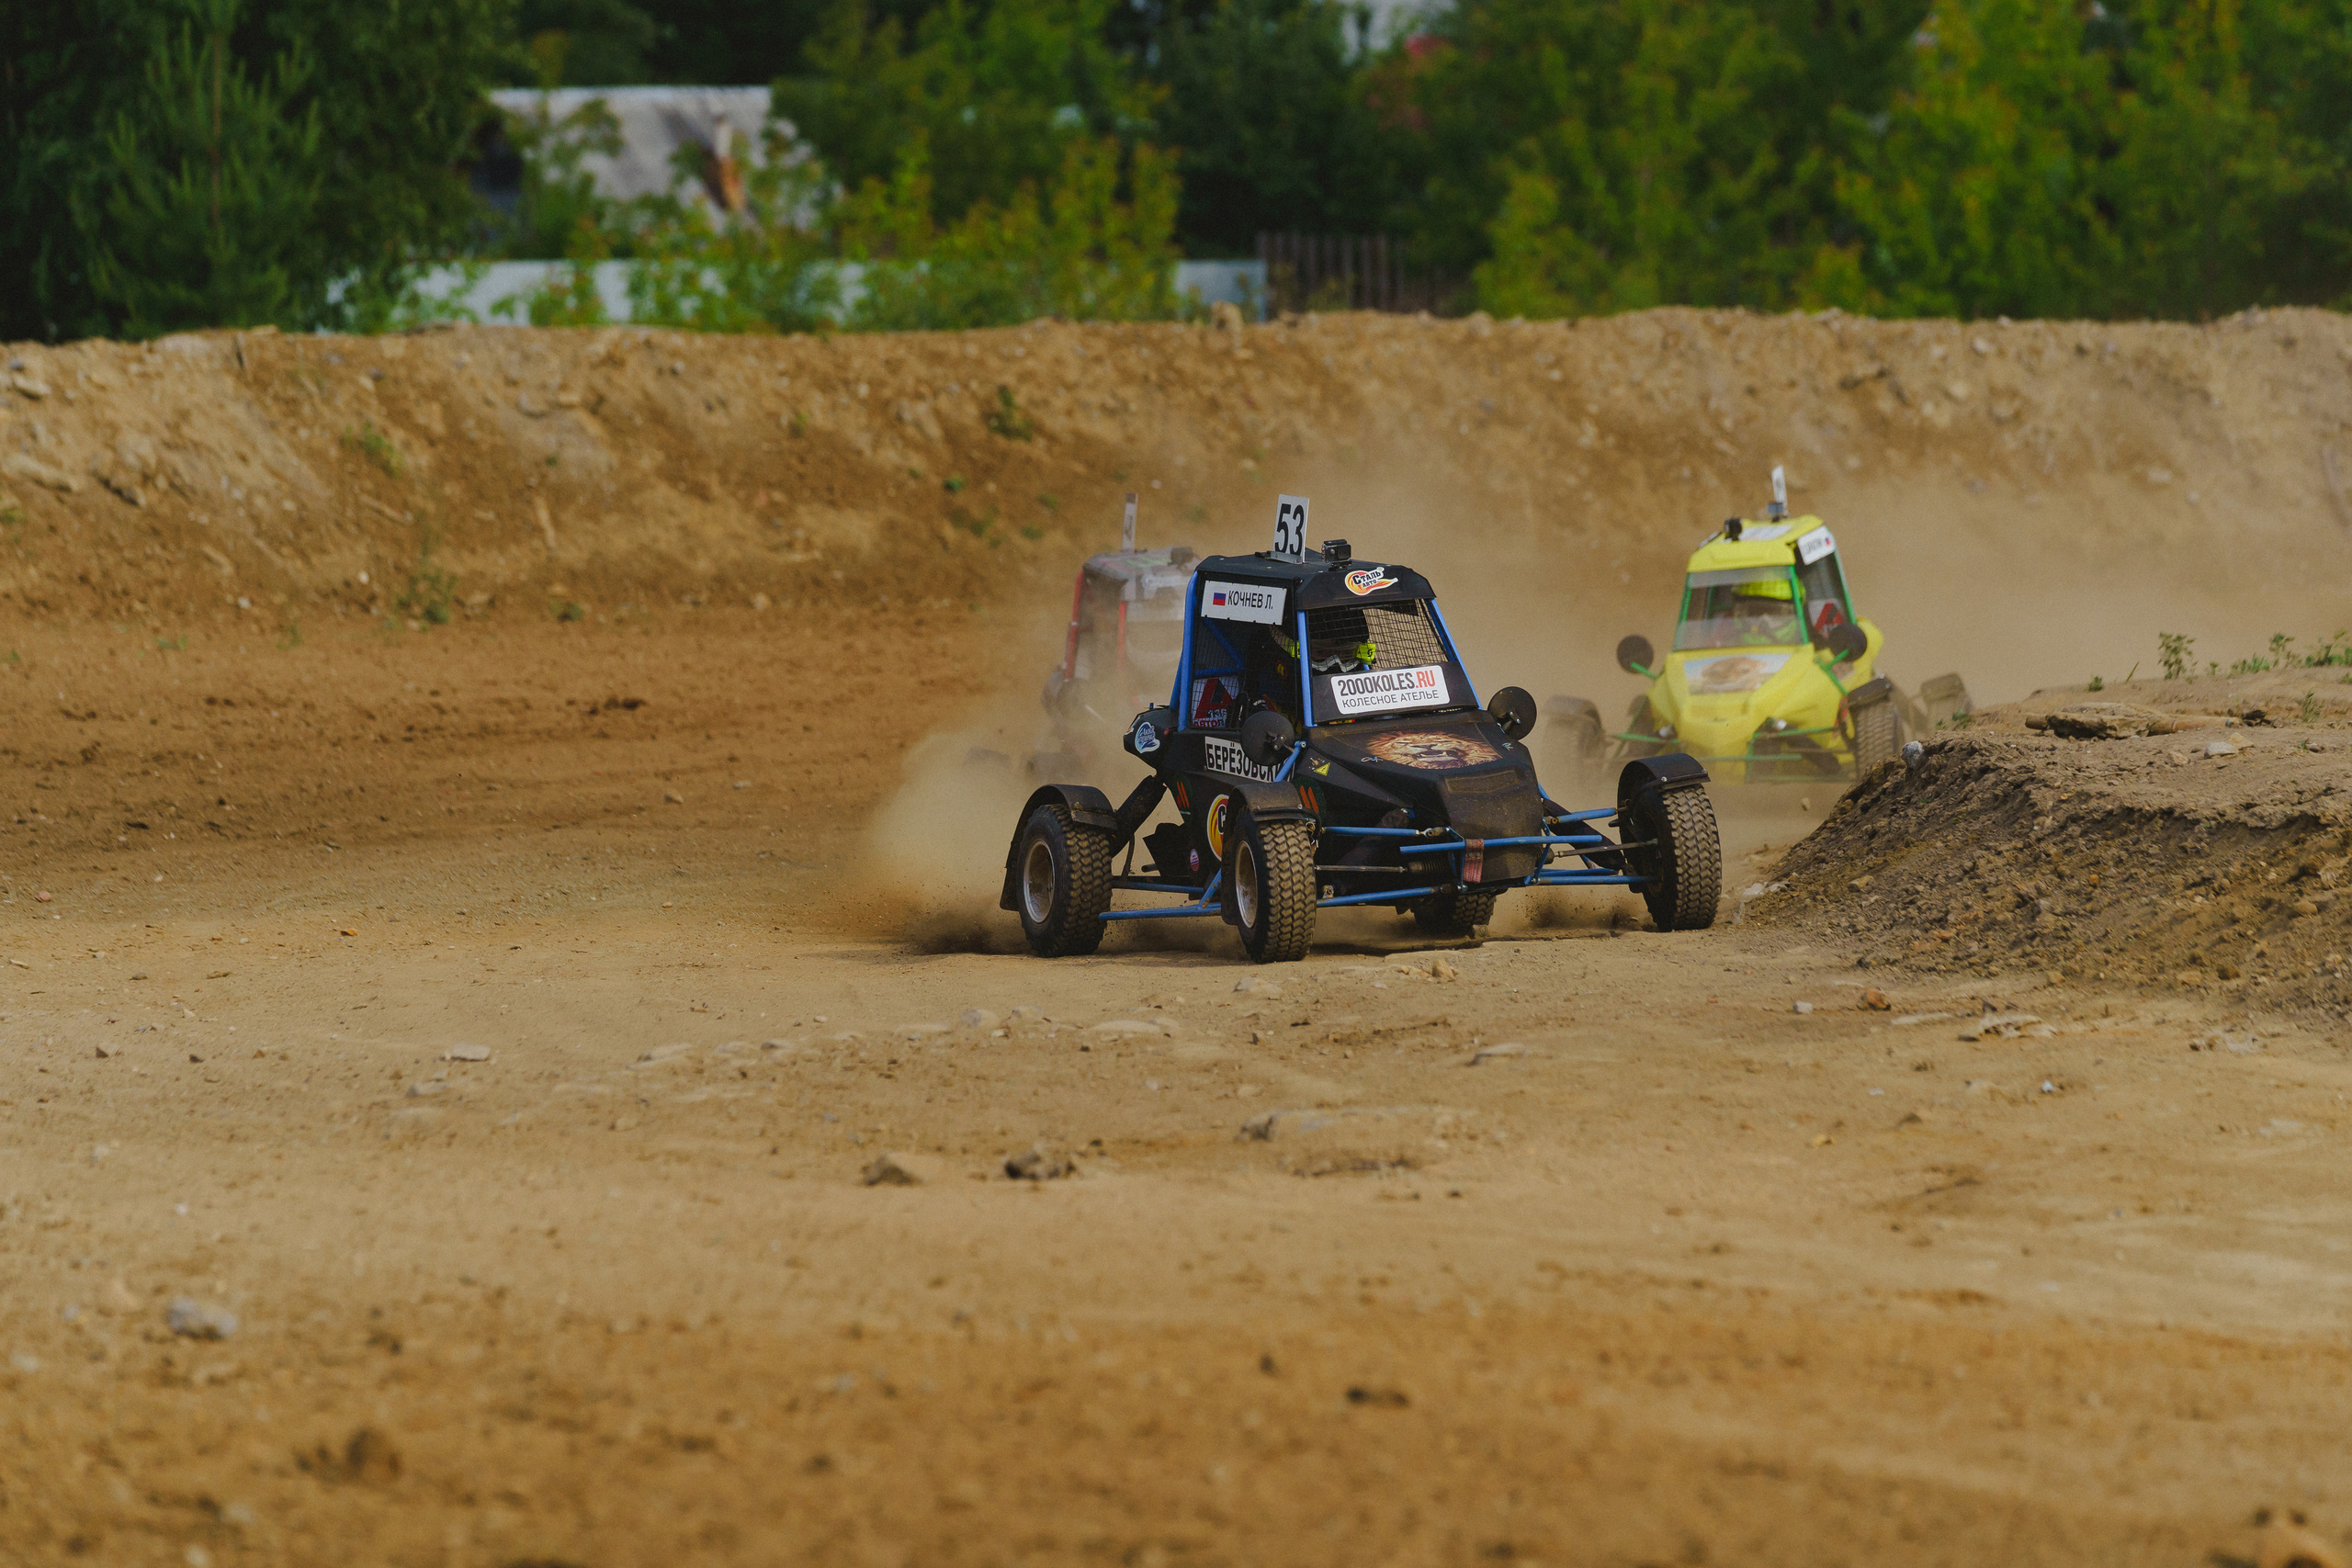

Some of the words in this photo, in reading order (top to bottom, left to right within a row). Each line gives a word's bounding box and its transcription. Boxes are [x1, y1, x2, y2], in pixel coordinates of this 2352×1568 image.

[1274, 502, 1305, 557] 53
[1227, 590, 1264, 609] КОЧНЕВ
[1264, 593, 1273, 610] Л.
[1338, 670, 1436, 696] 2000KOLES.RU
[1341, 694, 1398, 708] КОЛЕСНОЕ
[1400, 689, 1440, 703] АТЕЛЬЕ
